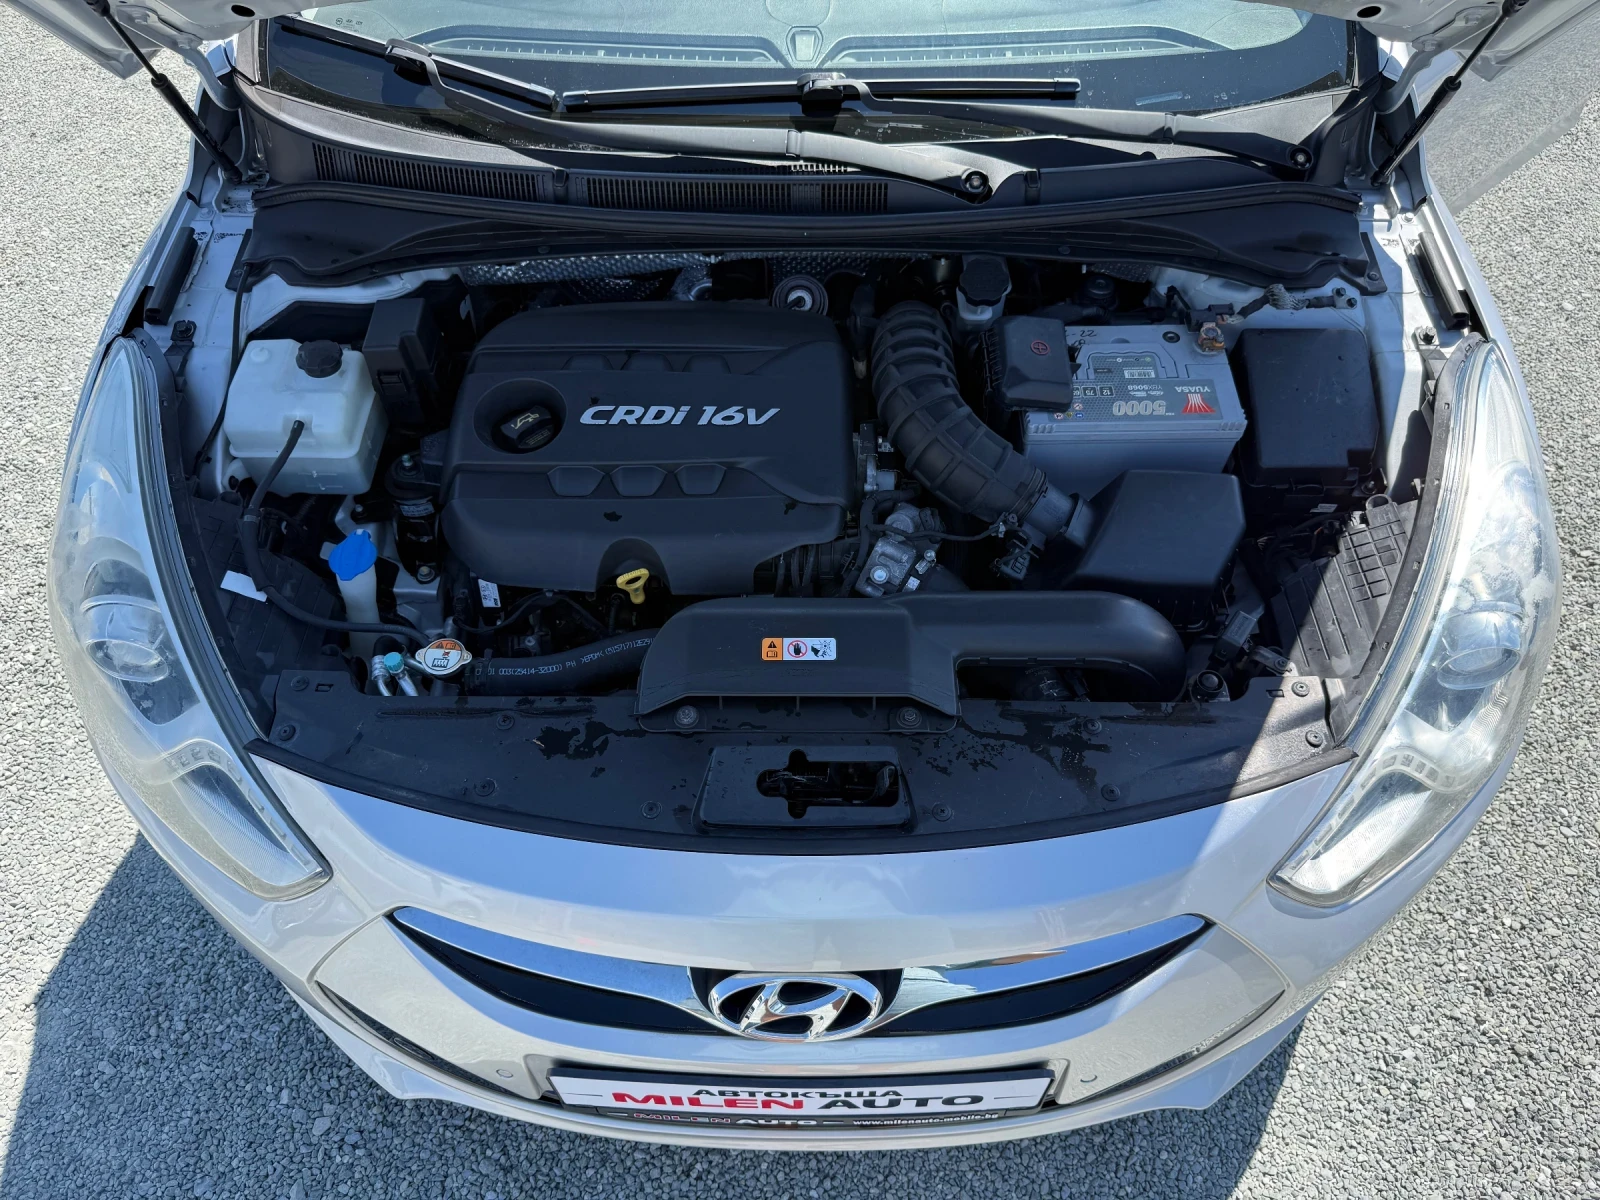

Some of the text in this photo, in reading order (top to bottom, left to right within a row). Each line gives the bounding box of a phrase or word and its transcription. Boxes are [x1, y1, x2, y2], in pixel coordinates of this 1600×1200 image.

[1174, 385, 1211, 394] YUASA
[579, 405, 781, 426] CRDi 16V
[1112, 400, 1167, 416] 5000
[565, 659, 577, 669] PH
[611, 1092, 984, 1110] MILEN AUTO
[633, 1112, 818, 1126] MILEN AUTO
